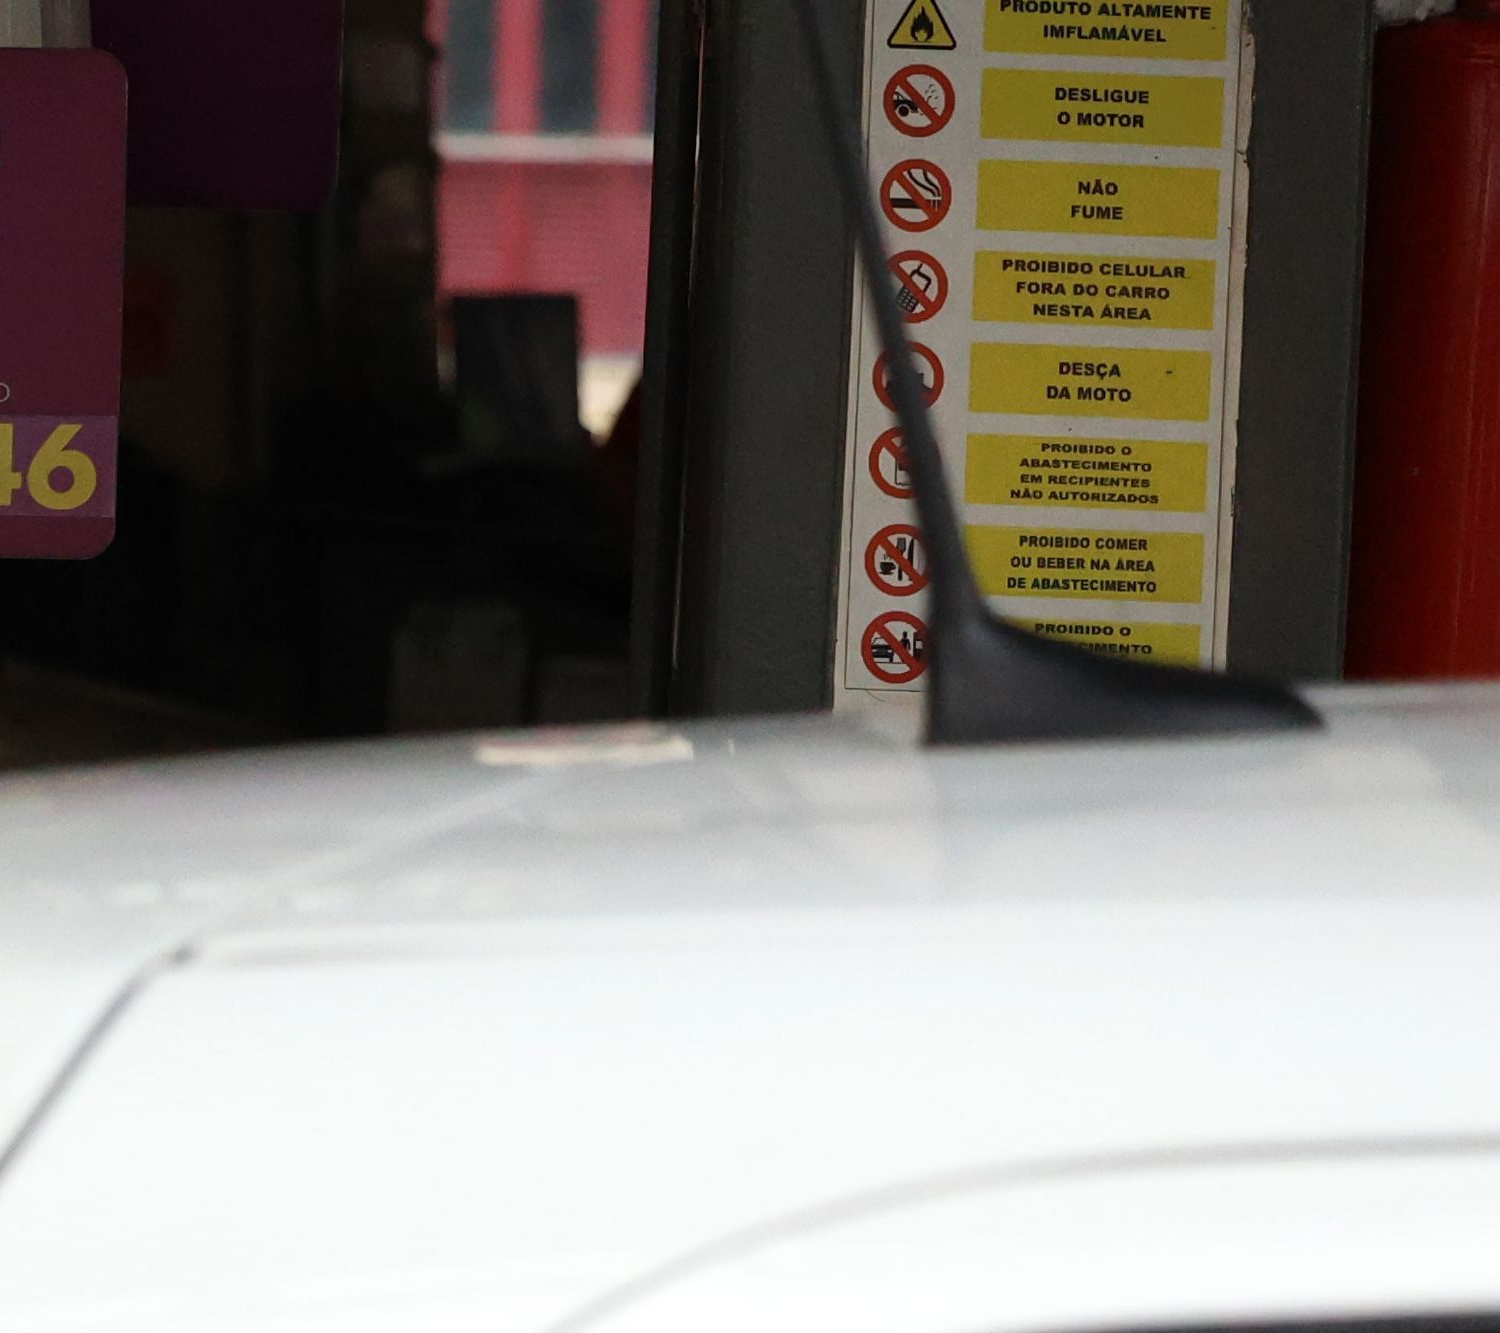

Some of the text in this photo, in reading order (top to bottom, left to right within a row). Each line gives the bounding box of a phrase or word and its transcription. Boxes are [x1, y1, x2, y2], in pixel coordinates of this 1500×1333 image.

[1000, 0, 1211, 20] PRODUTO ALTAMENTE
[1043, 25, 1166, 42] IMFLAMÁVEL
[1055, 87, 1149, 104] DESLIGUE
[1057, 111, 1145, 128] O MOTOR
[1077, 179, 1119, 196] NÃO
[1070, 205, 1124, 221] FUME
[1002, 259, 1186, 279] PROIBIDO CELULAR
[1016, 281, 1171, 300] FORA DO CARRO
[1033, 302, 1152, 321] NESTA ÁREA
[1058, 361, 1122, 380] DESÇA
[1047, 386, 1132, 402] DA MOTO
[1041, 443, 1115, 455] PROIBIDO
[1020, 458, 1152, 472] ABASTECIMENTO
[1047, 475, 1150, 488] RECIPIENTES
[1048, 490, 1159, 504] AUTORIZADOS
[1019, 535, 1148, 551] PROIBIDO COMER
[1036, 557, 1085, 570] BEBER
[1031, 577, 1157, 592] ABASTECIMENTO
